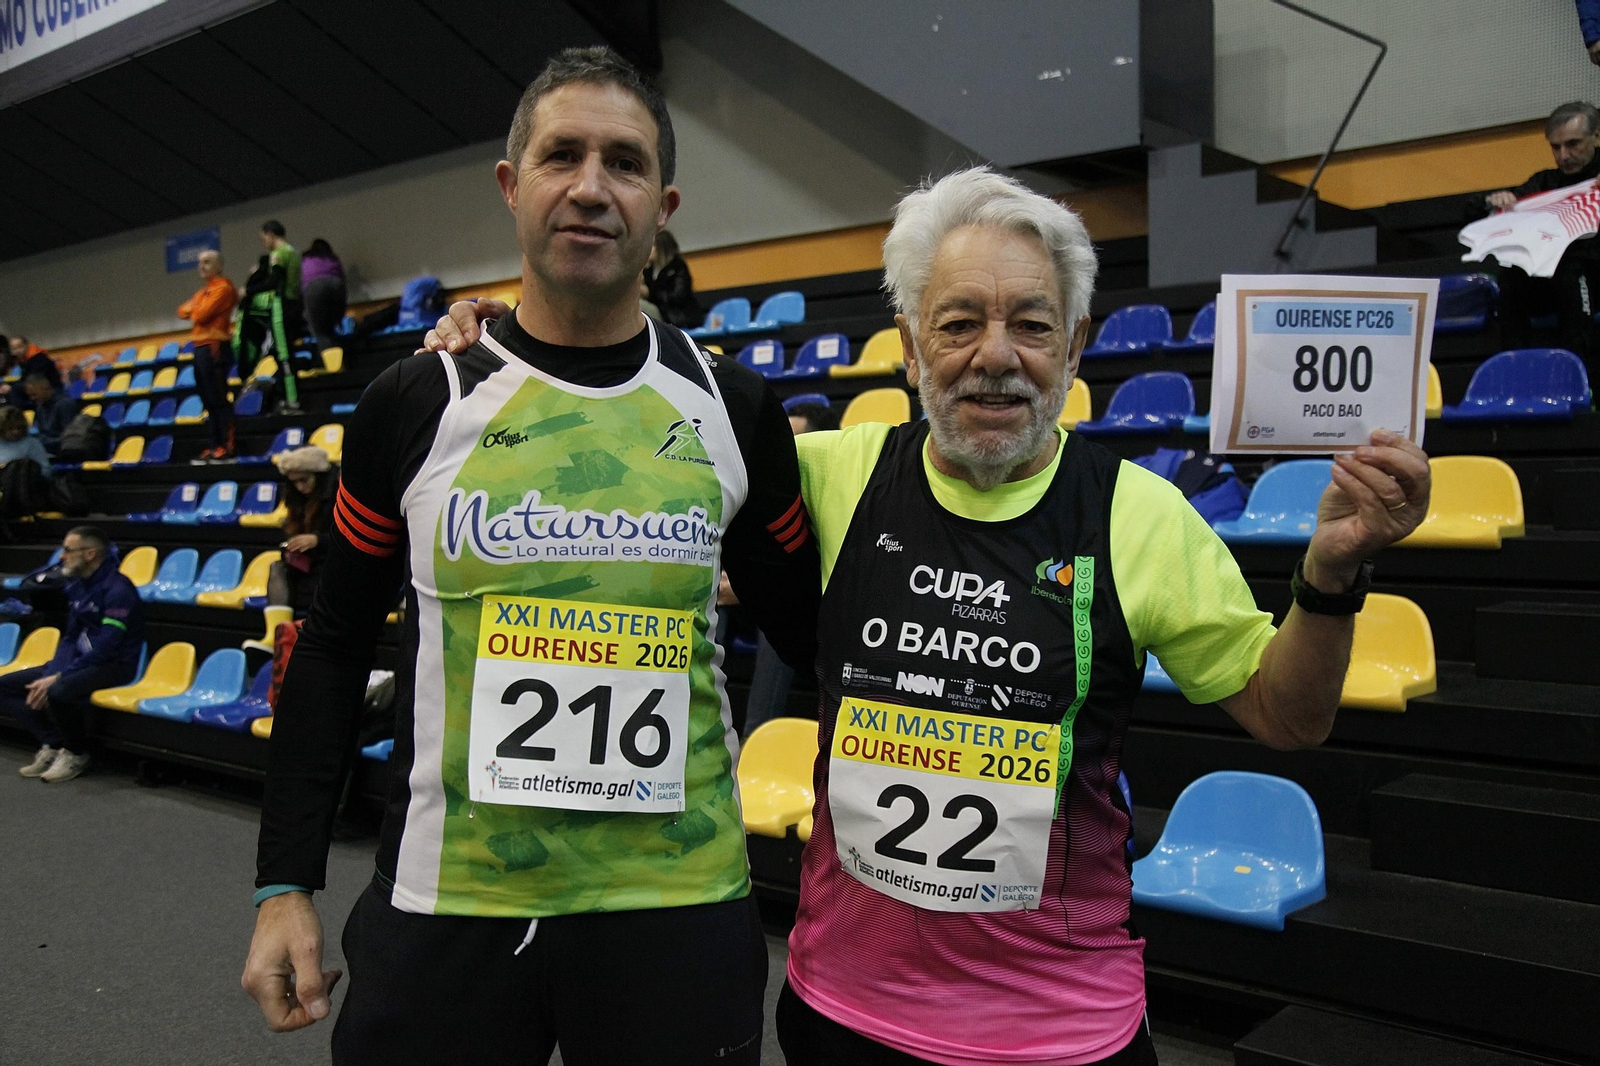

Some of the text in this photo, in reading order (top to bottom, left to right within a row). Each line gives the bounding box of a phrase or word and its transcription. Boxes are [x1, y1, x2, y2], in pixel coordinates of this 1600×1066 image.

[1276, 308, 1394, 329] OURENSE PC26
[1293, 345, 1373, 393] 800
[1303, 404, 1362, 418] PACO BAO
[446, 492, 719, 560] Natursueño
[516, 544, 538, 557] Lo
[546, 542, 614, 557] natural
[623, 546, 641, 557] es
[648, 544, 699, 560] dormir
[909, 564, 1011, 608] CUPA
[495, 602, 686, 639] XXI MASTER PC
[951, 602, 1007, 625] PIZARRAS
[488, 633, 688, 669] OURENSE 2026
[862, 617, 1041, 673] O BARCO
[896, 671, 945, 697] NON
[1015, 688, 1052, 702] DEPORTE
[951, 699, 982, 711] OURENSE
[1013, 696, 1047, 708] GALEGO
[496, 678, 671, 769] 216
[848, 705, 1048, 752] XXI MASTER PC
[841, 735, 1051, 783] OURENSE 2026
[522, 774, 635, 800] atletismo.gal
[657, 781, 682, 791] DEPORTE
[657, 791, 680, 801] GALEGO
[874, 783, 999, 873] 22
[876, 868, 979, 902] atletismo.gal
[1002, 885, 1039, 894] DEPORTE
[1002, 892, 1035, 901] GALEGO
